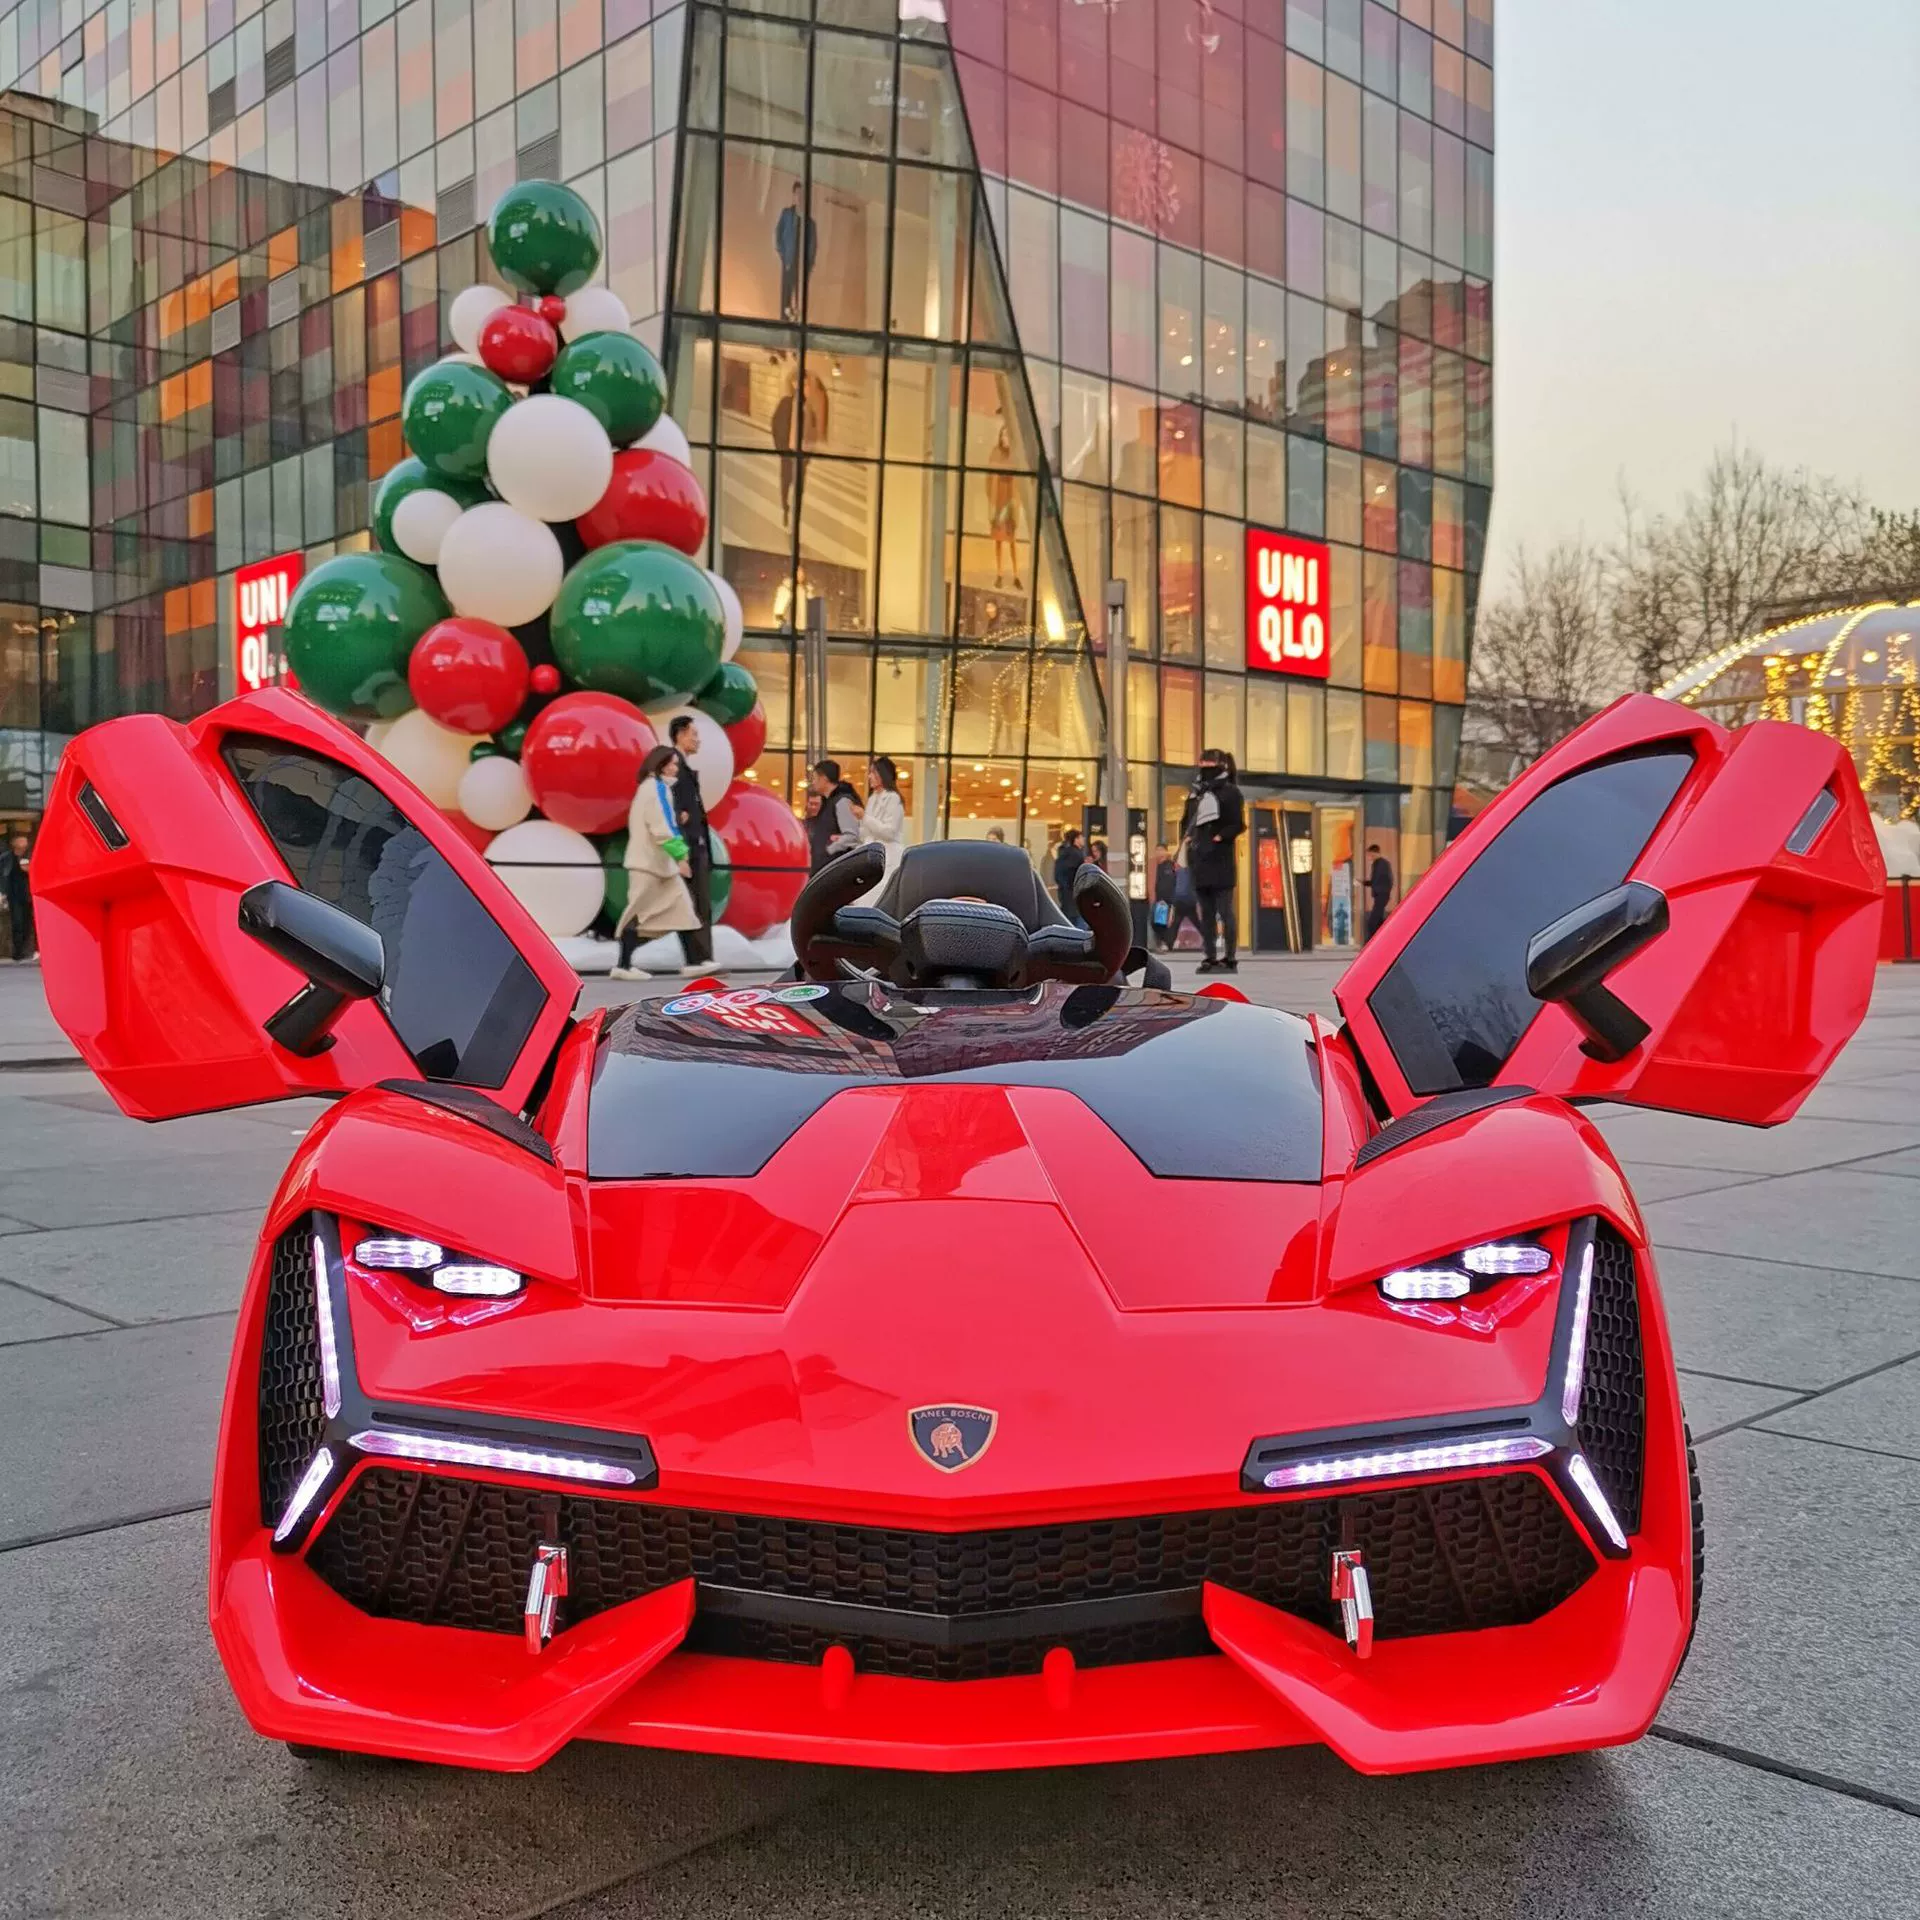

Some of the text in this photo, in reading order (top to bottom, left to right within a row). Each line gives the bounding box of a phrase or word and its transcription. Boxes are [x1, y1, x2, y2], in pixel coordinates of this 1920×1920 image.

[241, 571, 288, 628] UNI
[1258, 547, 1318, 606] UNI
[1258, 604, 1324, 663] QLO
[914, 1409, 948, 1420] LANEL
